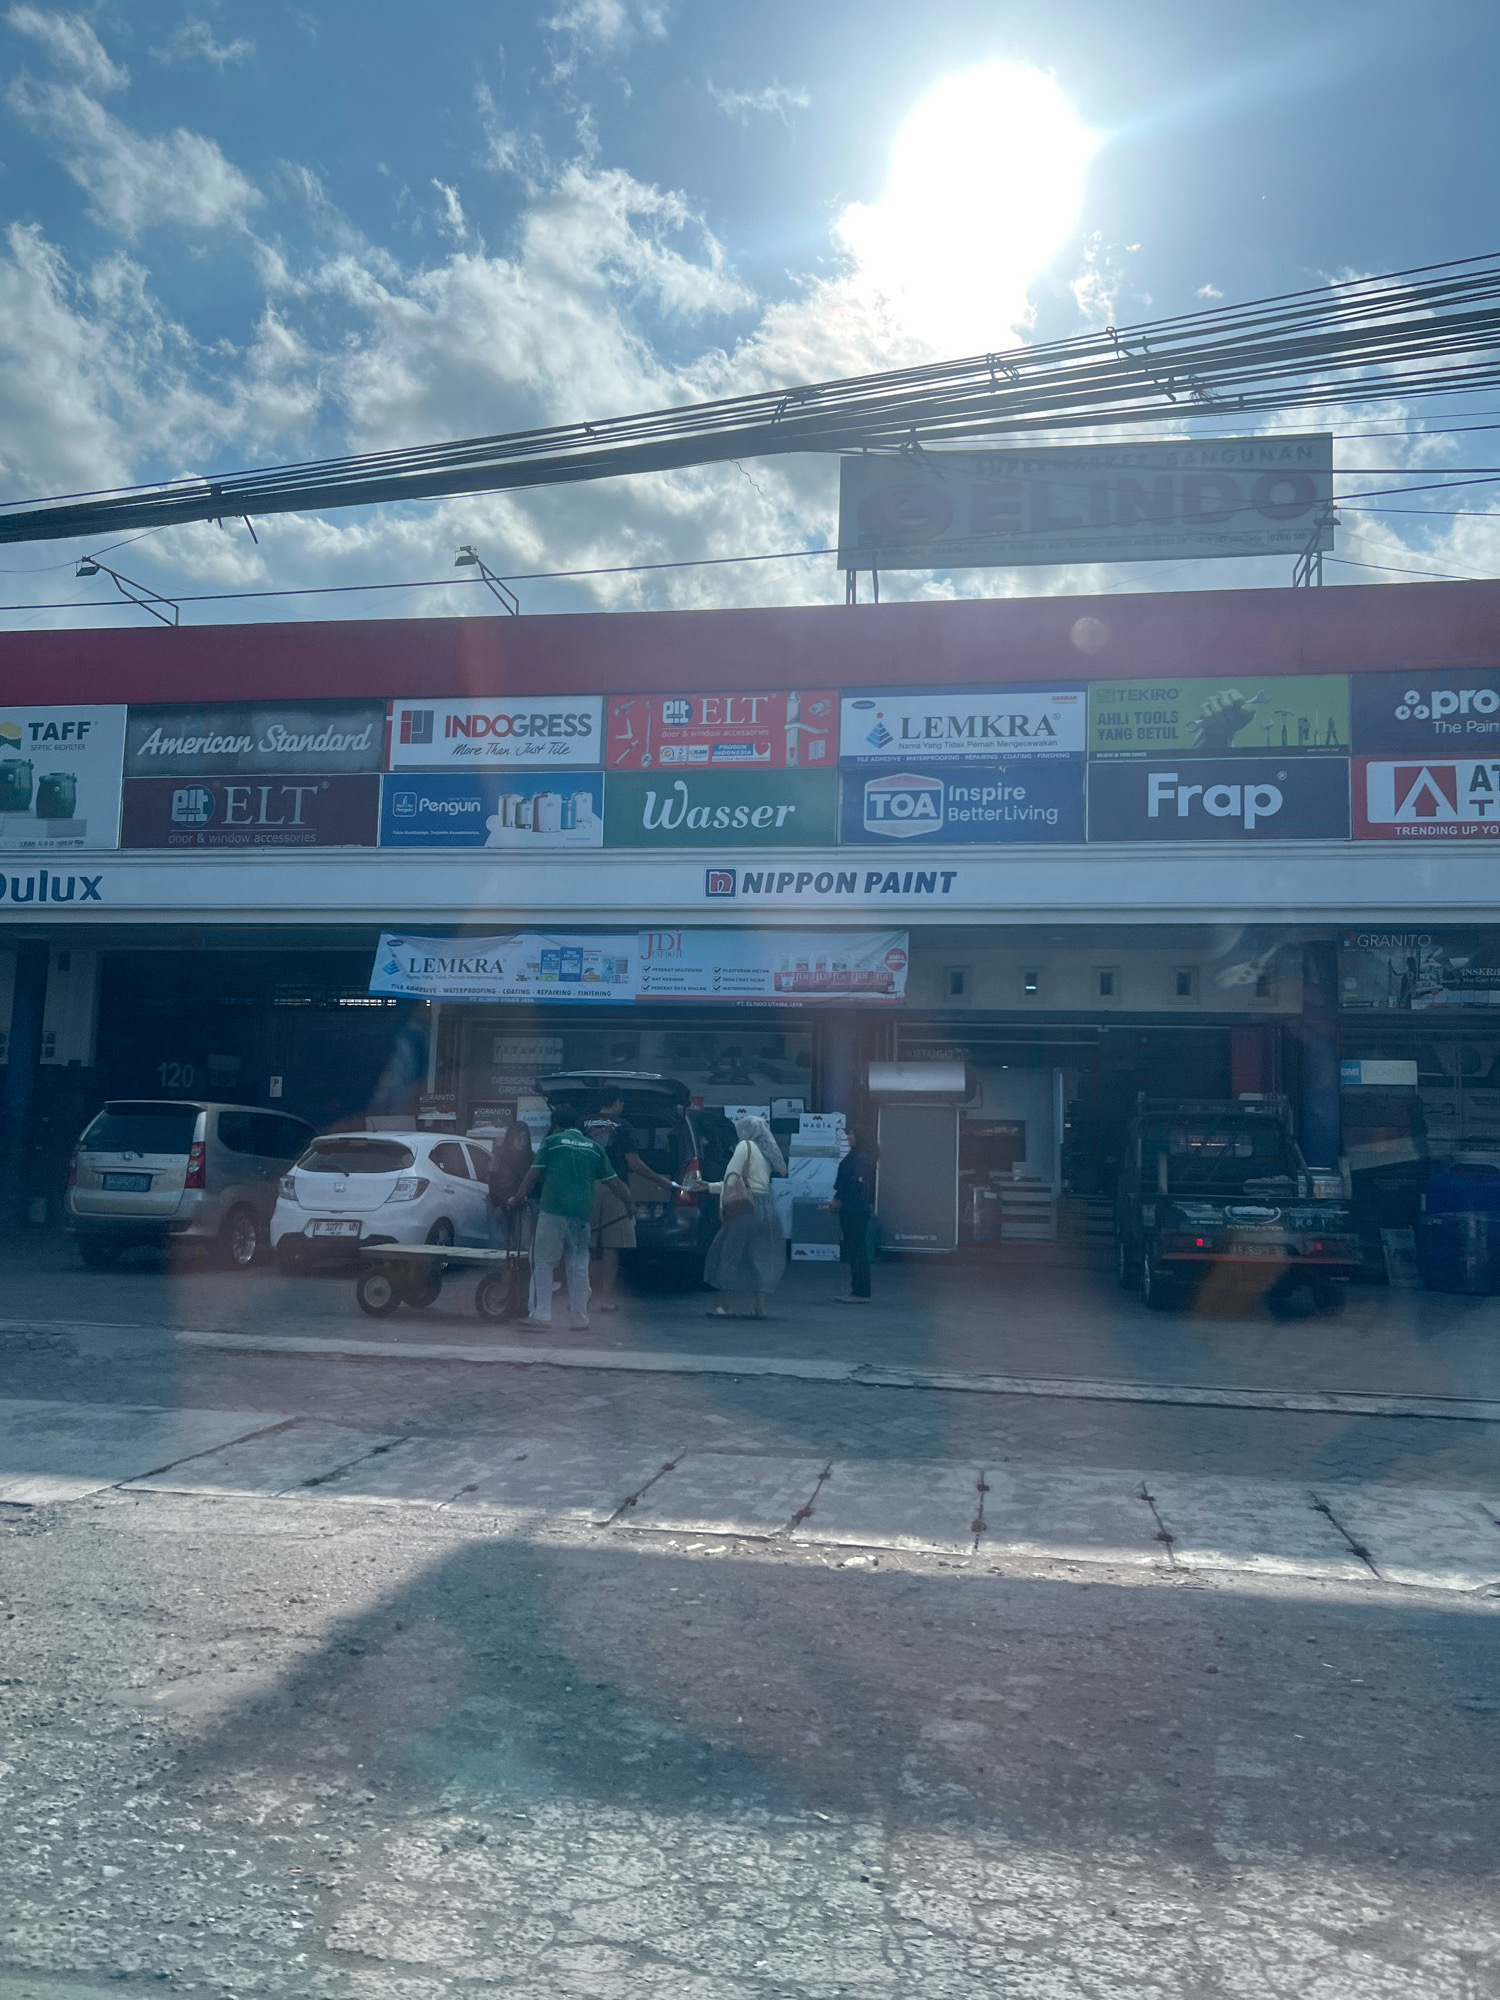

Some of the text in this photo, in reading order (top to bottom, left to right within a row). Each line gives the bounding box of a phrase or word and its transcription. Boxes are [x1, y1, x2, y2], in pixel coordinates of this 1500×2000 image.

[976, 444, 1313, 475] SUPERMARKET BANGUNAN
[971, 472, 1317, 534] ELINDO
[1117, 688, 1179, 701] TEKIRO
[699, 697, 768, 724] ELT
[1098, 711, 1178, 725] AHLI TOOLS
[28, 721, 91, 741] TAFF
[445, 713, 592, 738] INDOGRESS
[662, 729, 679, 738] door
[691, 729, 721, 737] window
[723, 728, 769, 736] accessories
[899, 714, 1057, 739] LEMKRA
[1098, 726, 1178, 741] YANG BETUL
[1432, 721, 1462, 734] The
[137, 723, 373, 755] American Standard
[452, 741, 571, 756] More Than Just Tile
[923, 742, 942, 750] Yang
[997, 740, 1057, 748] Mengecewakan
[949, 782, 1026, 805] Inspire
[1148, 773, 1283, 829] Frap
[221, 786, 318, 825] ELT
[419, 798, 480, 815] Penguin
[643, 780, 795, 829] Wasser
[870, 793, 937, 818] TOA
[948, 806, 1058, 824] Better Living
[168, 832, 316, 844] door & window accessories
[1395, 826, 1457, 835] TRENDING
[1462, 826, 1478, 834] UP
[0, 870, 103, 902] ulux
[742, 872, 857, 893] NIPPON
[864, 872, 957, 893] PAINT
[640, 933, 682, 960] JDI
[1356, 934, 1431, 947] GRANITO
[408, 957, 504, 973] LEMKRA
[405, 985, 437, 994] ADHESIVE
[443, 987, 497, 995] WATERPROOFING
[157, 1062, 195, 1088] 120
[479, 1108, 511, 1116] GRANITO
